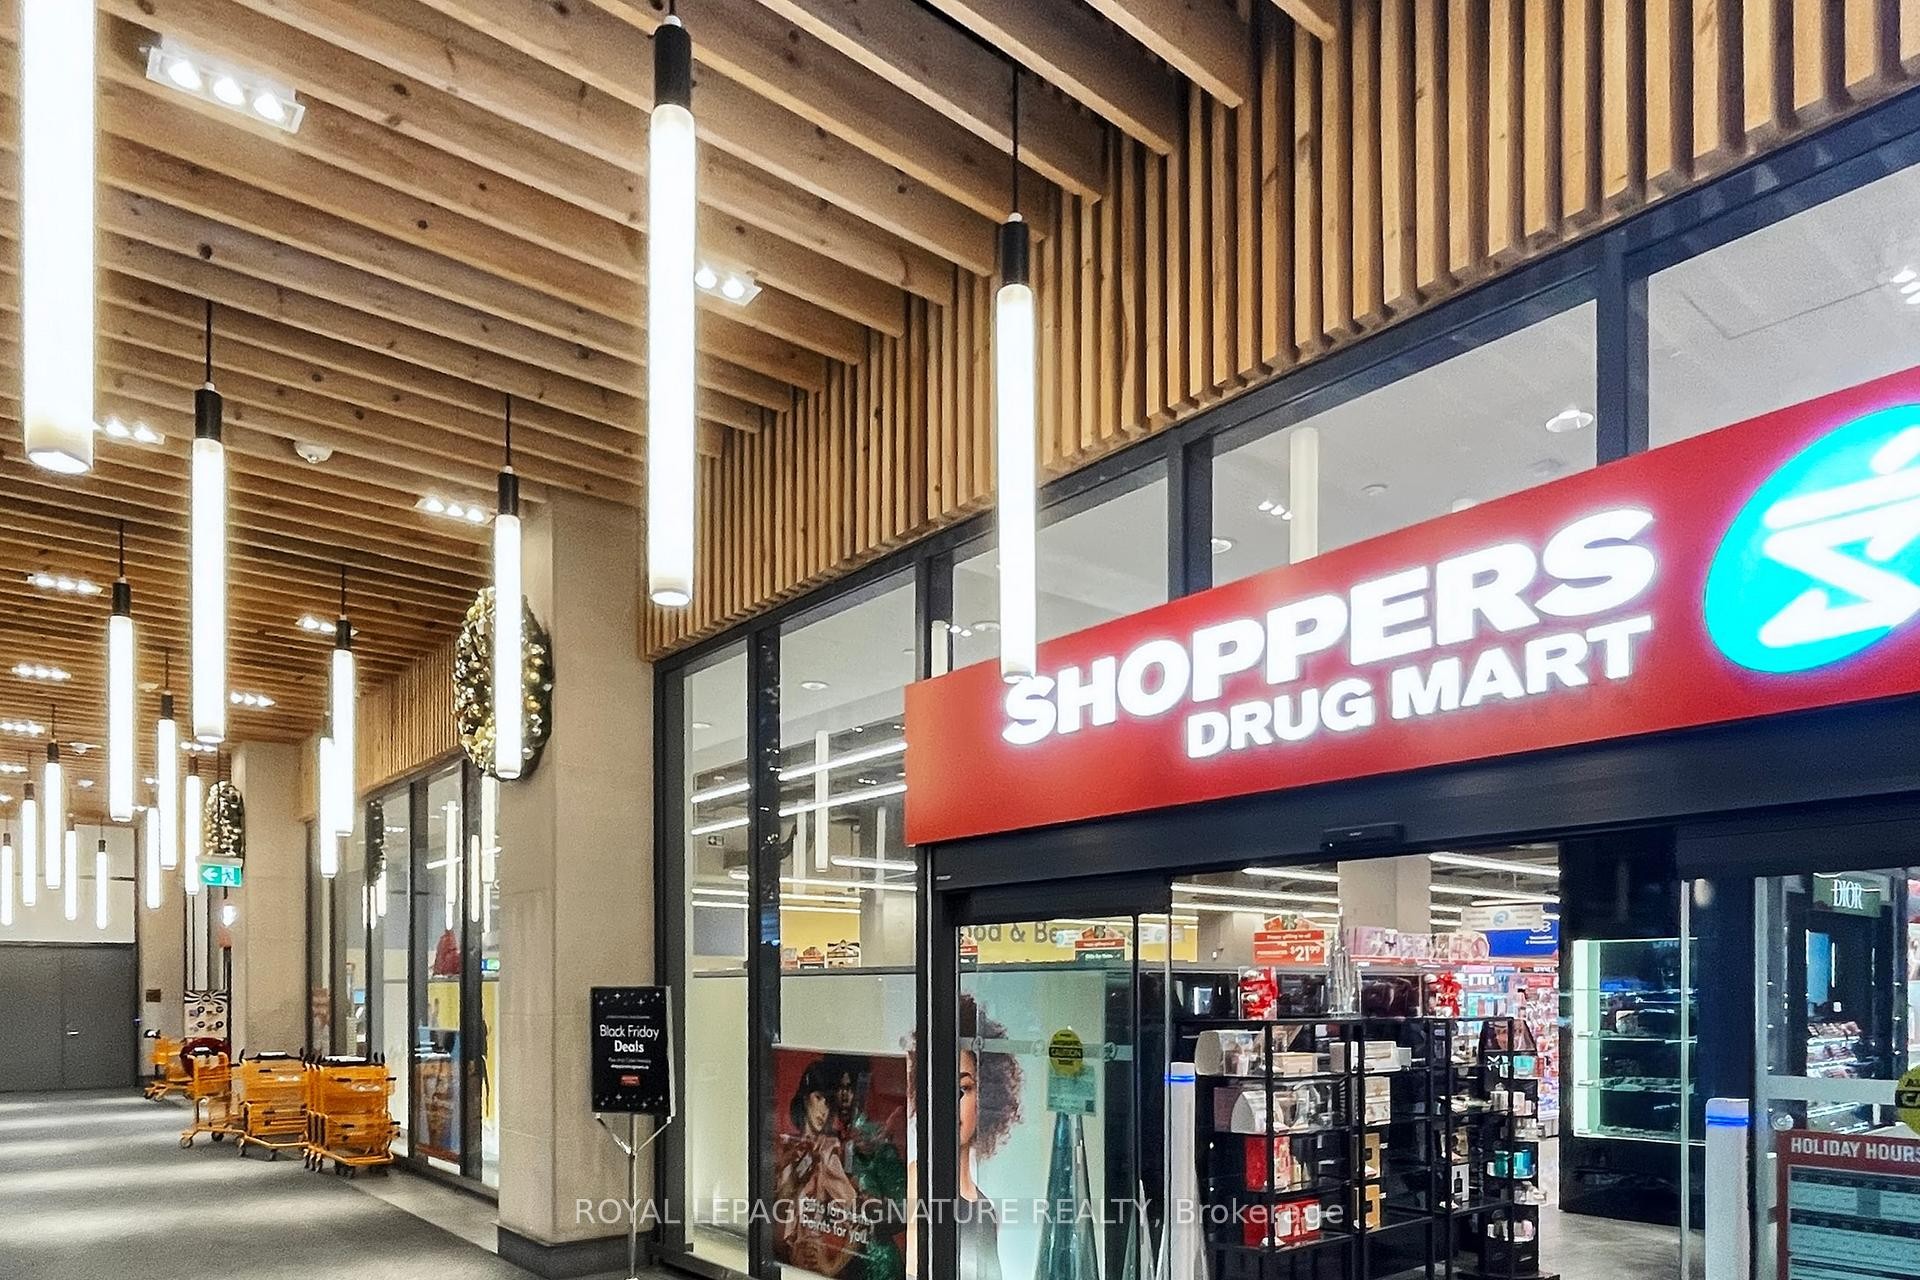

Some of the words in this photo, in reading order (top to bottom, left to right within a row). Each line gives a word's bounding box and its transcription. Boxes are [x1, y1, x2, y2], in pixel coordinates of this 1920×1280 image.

[1002, 508, 1656, 745] SHOPPERS
[1187, 678, 1374, 758] DRUG
[1391, 616, 1653, 719] MART
[1833, 879, 1863, 909] DIOR
[600, 1024, 625, 1037] Black
[628, 1024, 659, 1041] Friday
[614, 1040, 644, 1052] Deals
[1791, 1137, 1860, 1159] HOLIDAY
